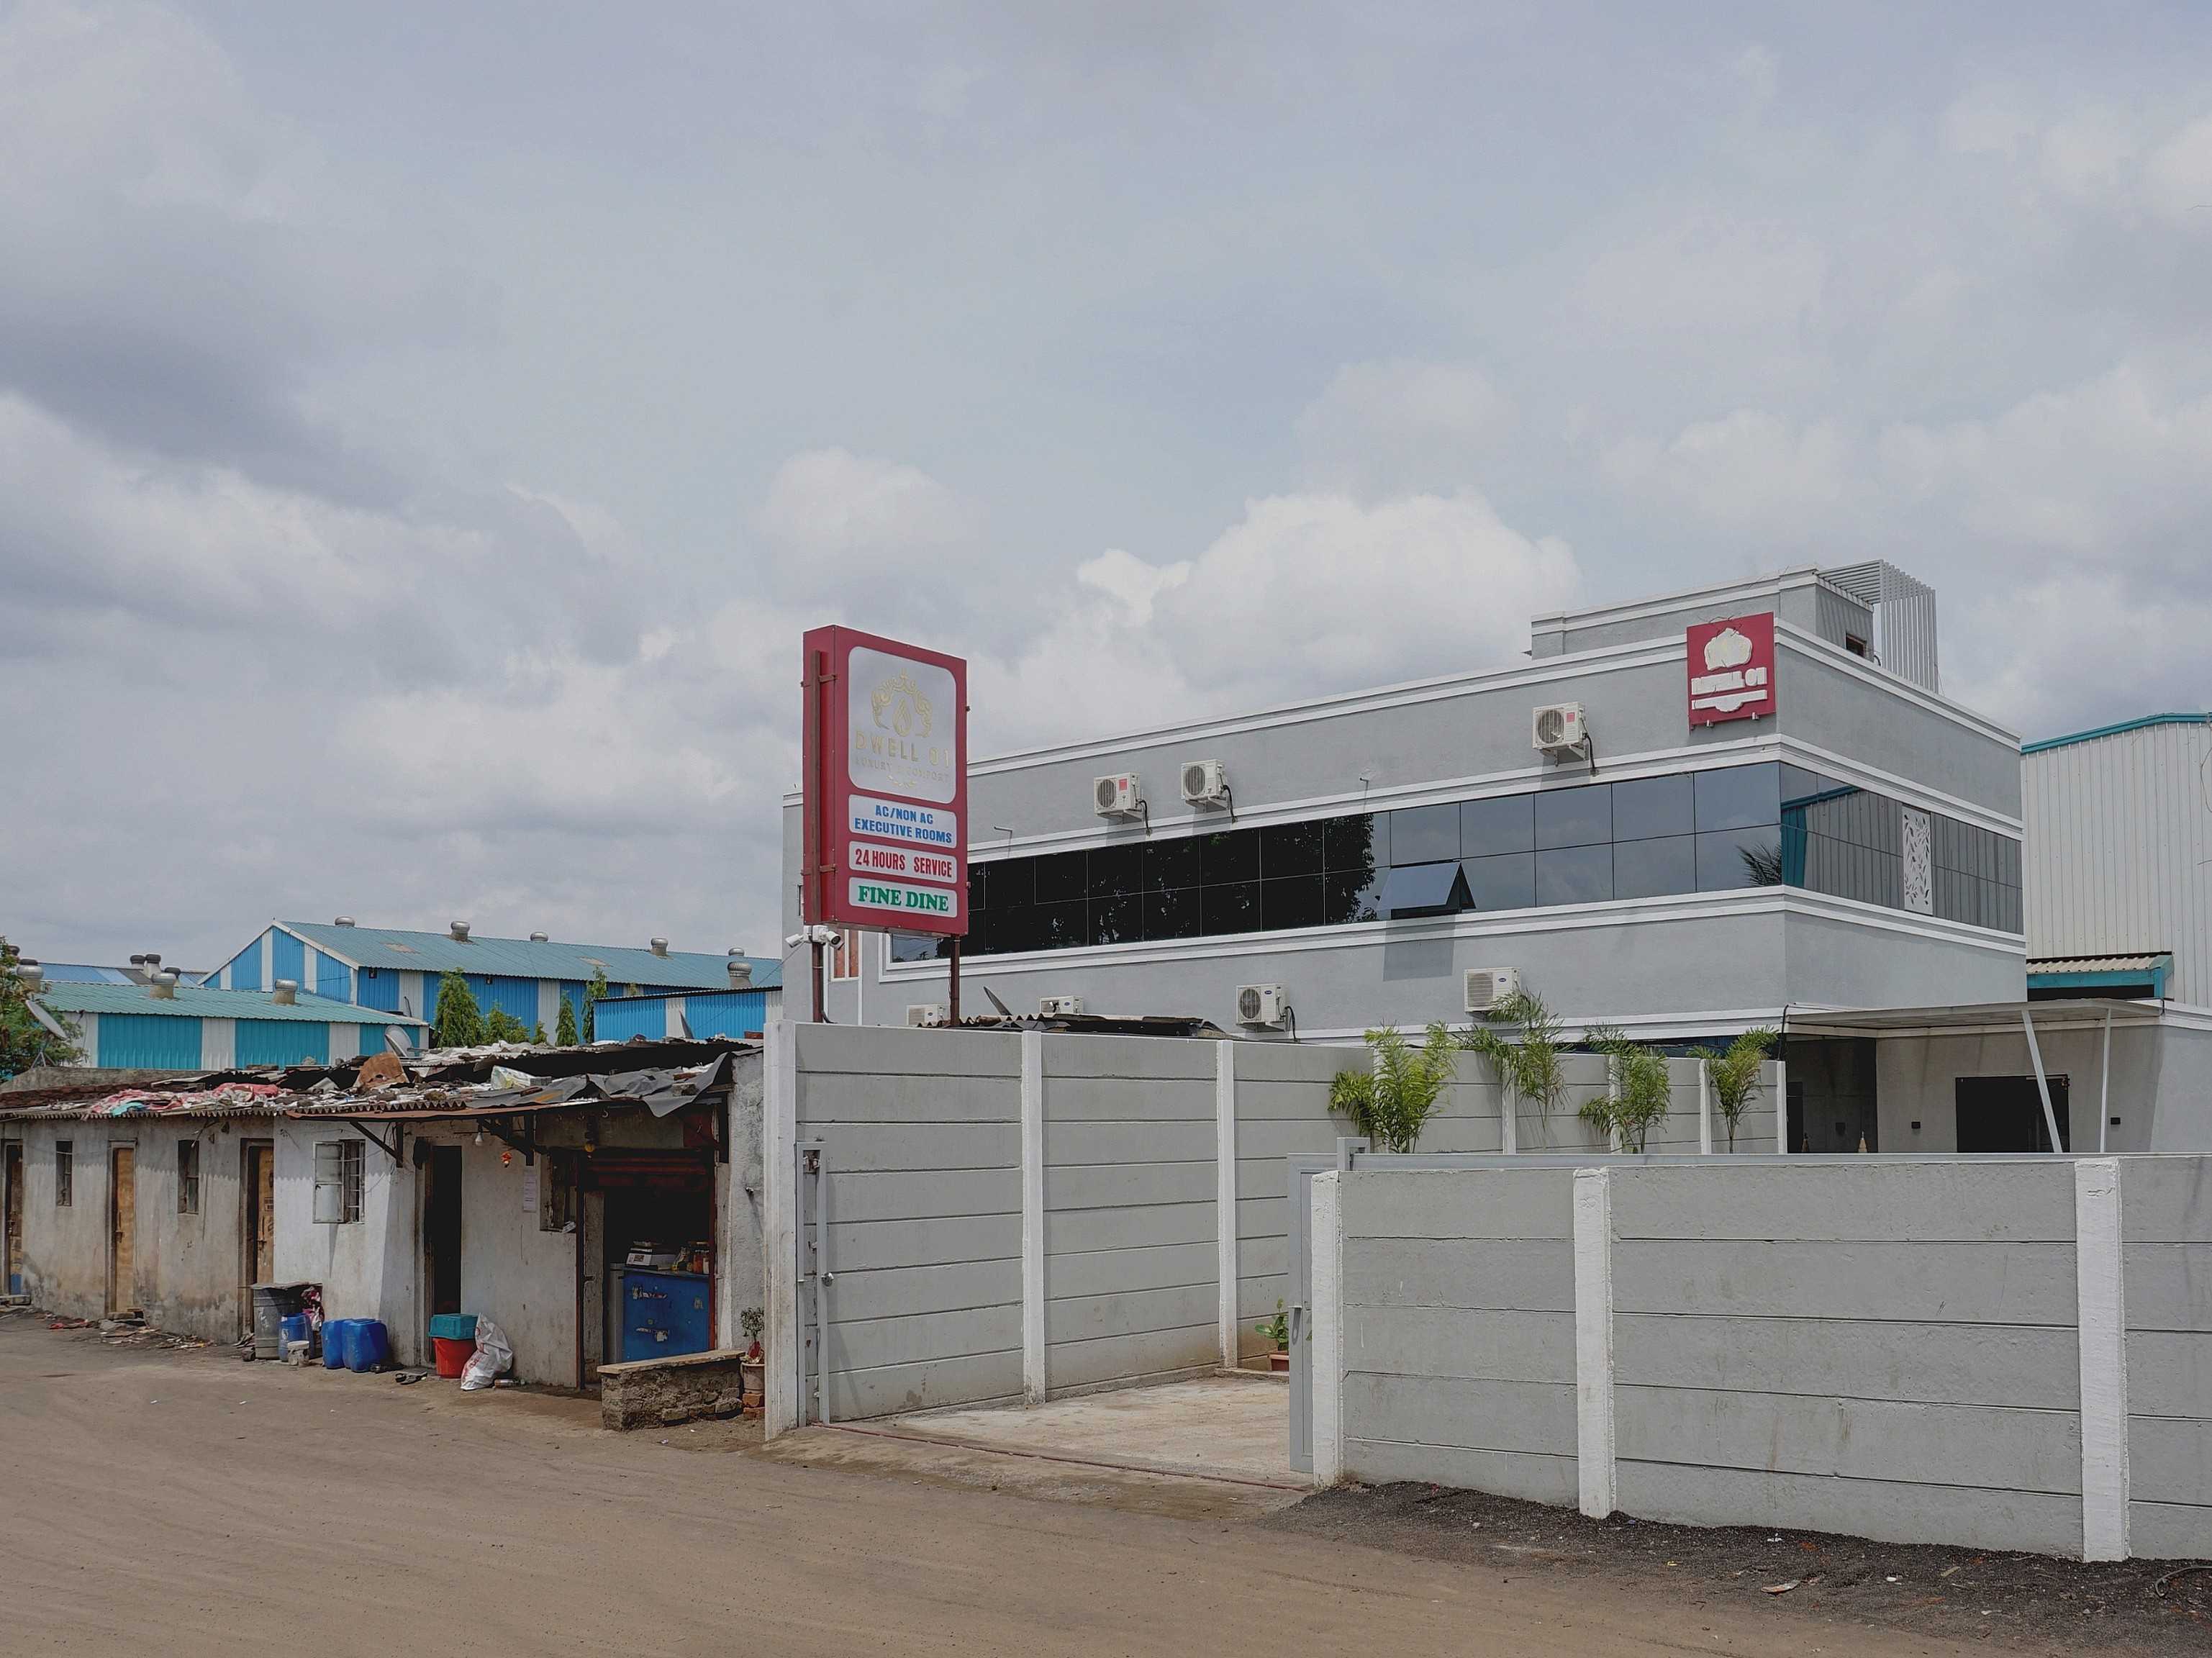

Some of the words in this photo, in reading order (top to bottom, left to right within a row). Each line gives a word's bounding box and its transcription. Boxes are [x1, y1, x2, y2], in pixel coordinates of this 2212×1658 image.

[855, 731, 920, 762] DWELL
[929, 747, 950, 769] 01
[875, 805, 917, 823] AC/NON
[920, 812, 933, 825] AC
[854, 817, 912, 838] EXECUTIVE
[915, 827, 952, 843] ROOMS
[855, 848, 870, 866] 24
[872, 851, 906, 871] HOURS
[914, 856, 952, 878] SERVICE
[858, 885, 902, 906] FINE
[905, 891, 949, 912] DINE
